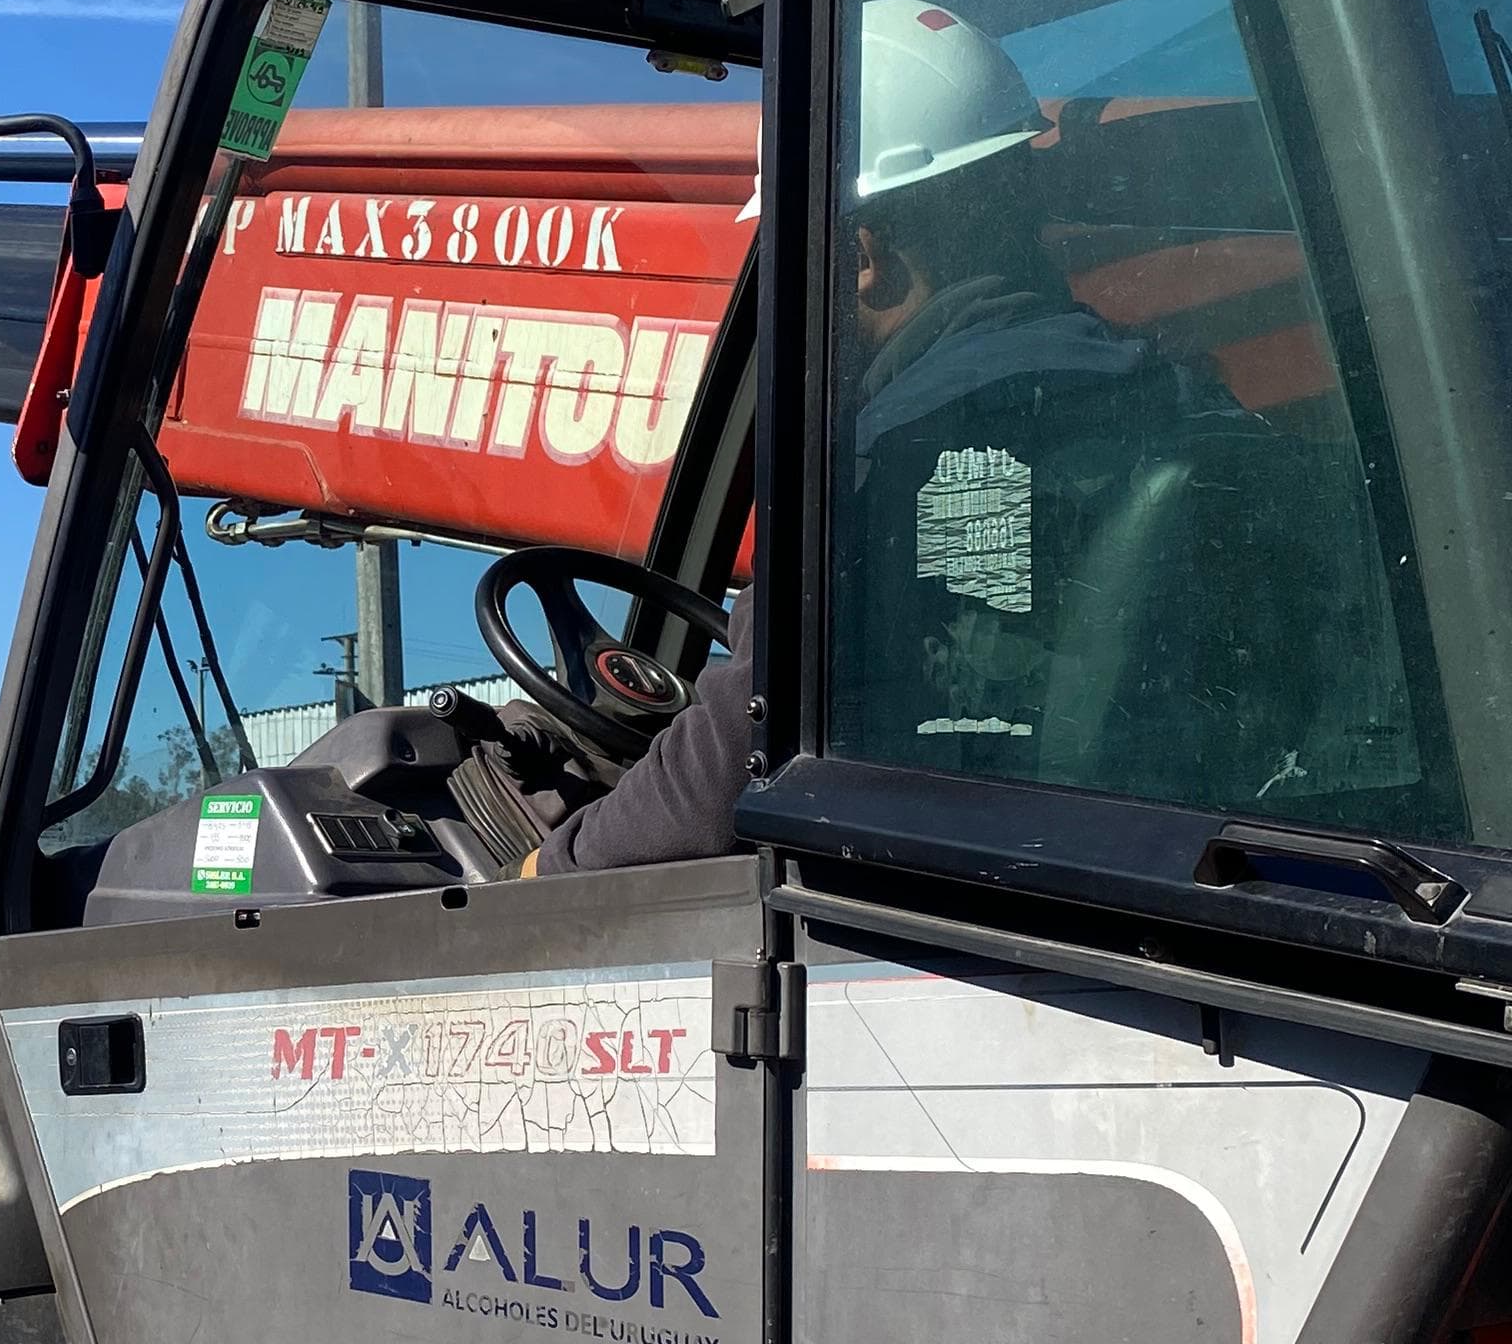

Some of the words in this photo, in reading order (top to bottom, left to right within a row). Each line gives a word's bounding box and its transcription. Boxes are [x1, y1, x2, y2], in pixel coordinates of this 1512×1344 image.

[240, 287, 718, 472] MANITOU
[207, 800, 253, 814] SERVICIO
[443, 1202, 722, 1319] ALUR
[442, 1288, 559, 1328] ALCOHOLES
